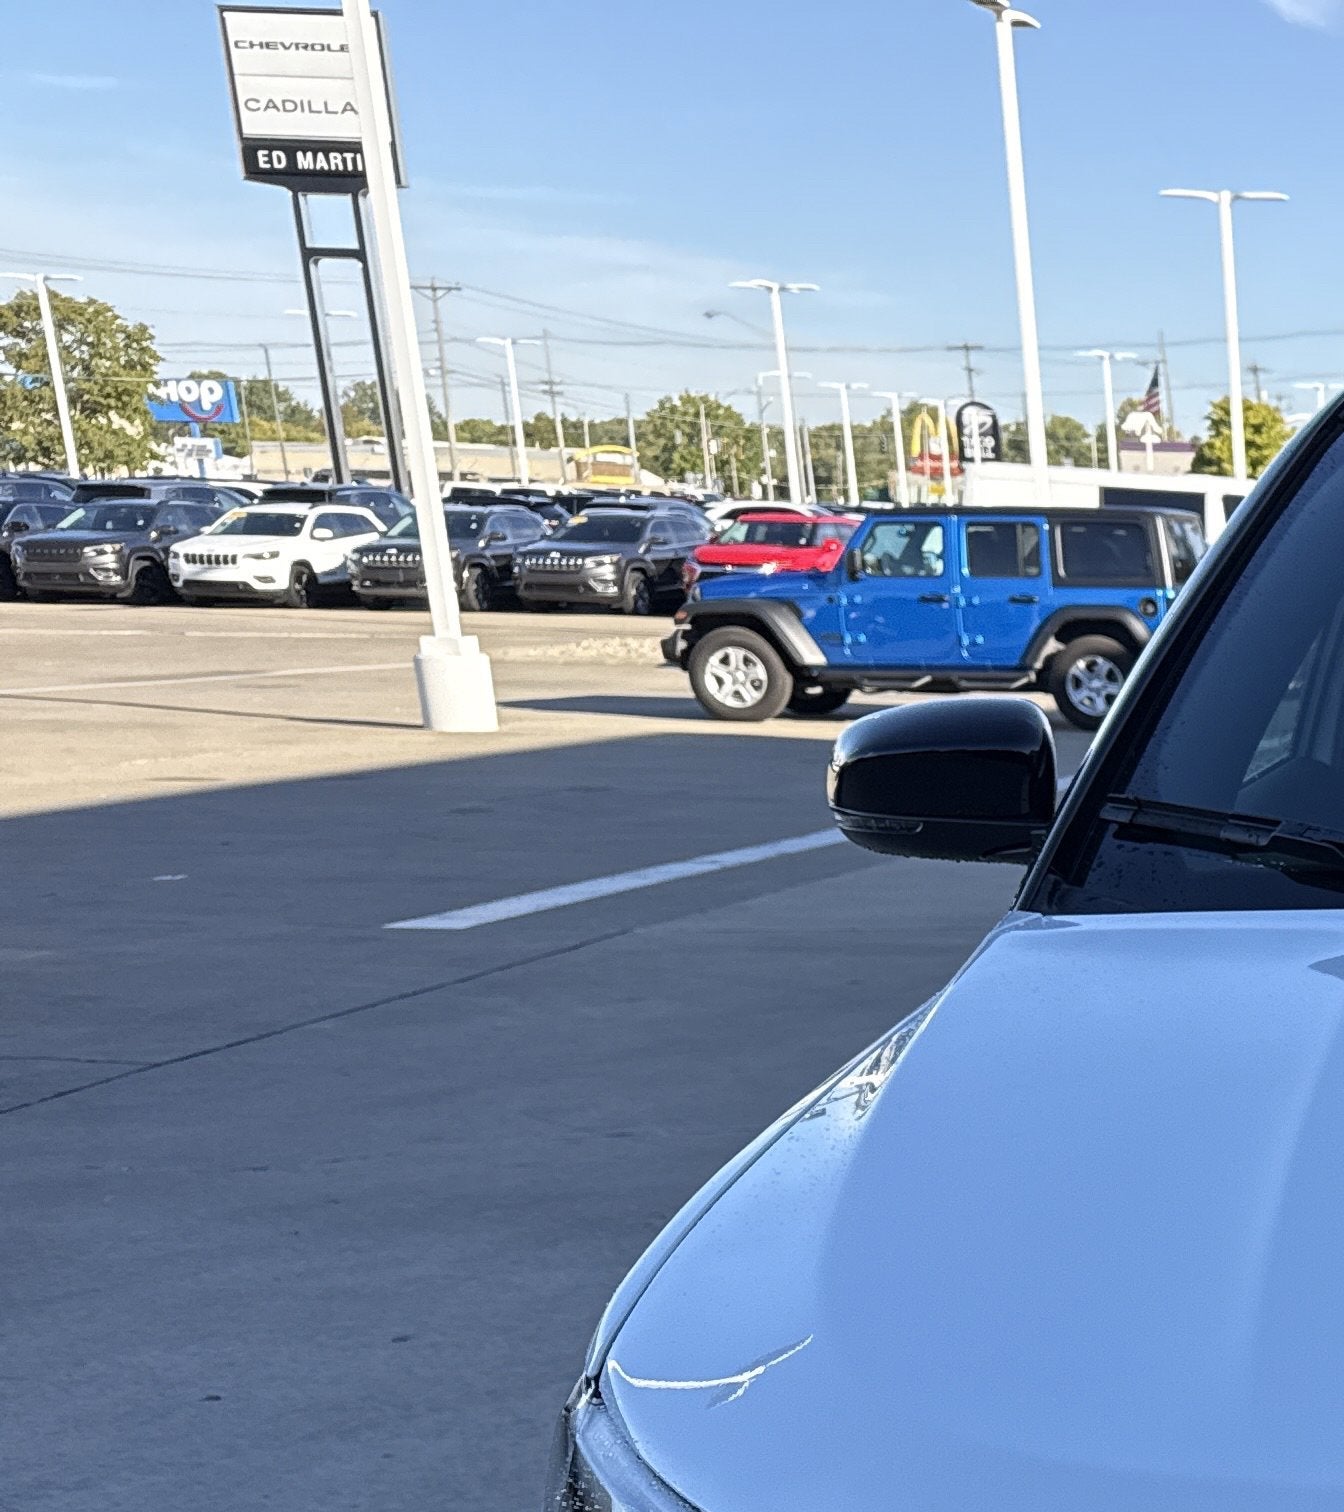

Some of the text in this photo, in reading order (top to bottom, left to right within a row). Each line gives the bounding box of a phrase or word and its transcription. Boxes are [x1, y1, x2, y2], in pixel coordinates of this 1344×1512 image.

[233, 40, 350, 53] CHEVROLE
[244, 98, 359, 115] CADILLA
[257, 150, 363, 171] ED MARTI
